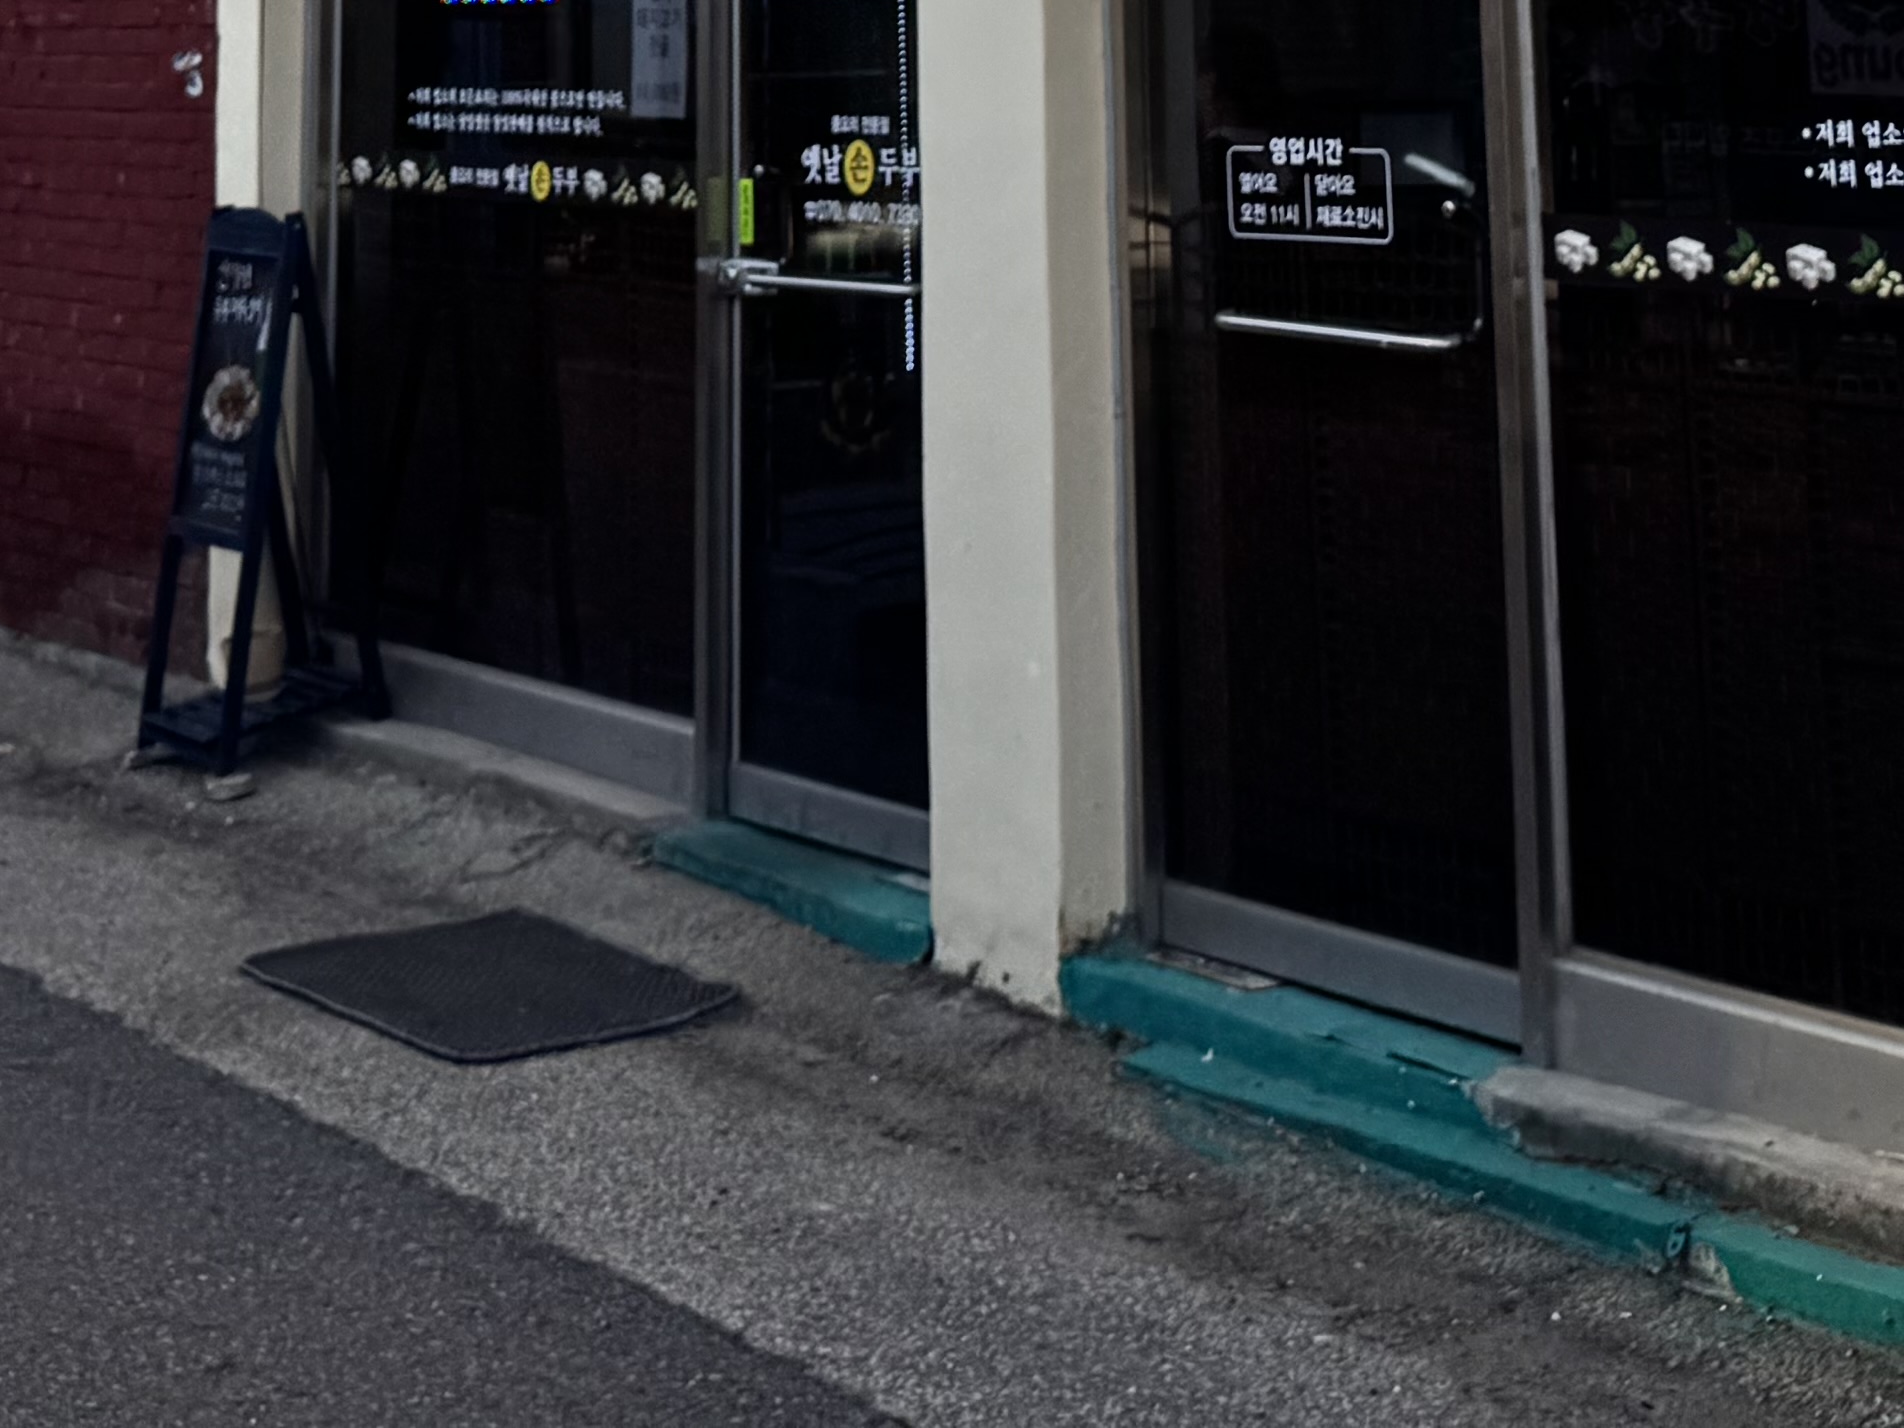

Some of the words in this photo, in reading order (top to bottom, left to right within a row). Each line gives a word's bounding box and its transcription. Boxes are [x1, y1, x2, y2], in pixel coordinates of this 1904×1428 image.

[1815, 119, 1855, 149] 저희
[800, 144, 842, 185] 옛날
[849, 147, 868, 184] 손
[878, 147, 921, 187] 두부
[1269, 137, 1343, 166] 영업시간
[1818, 158, 1857, 188] 저희
[1239, 202, 1267, 225] 오전
[1270, 203, 1300, 227] 11시
